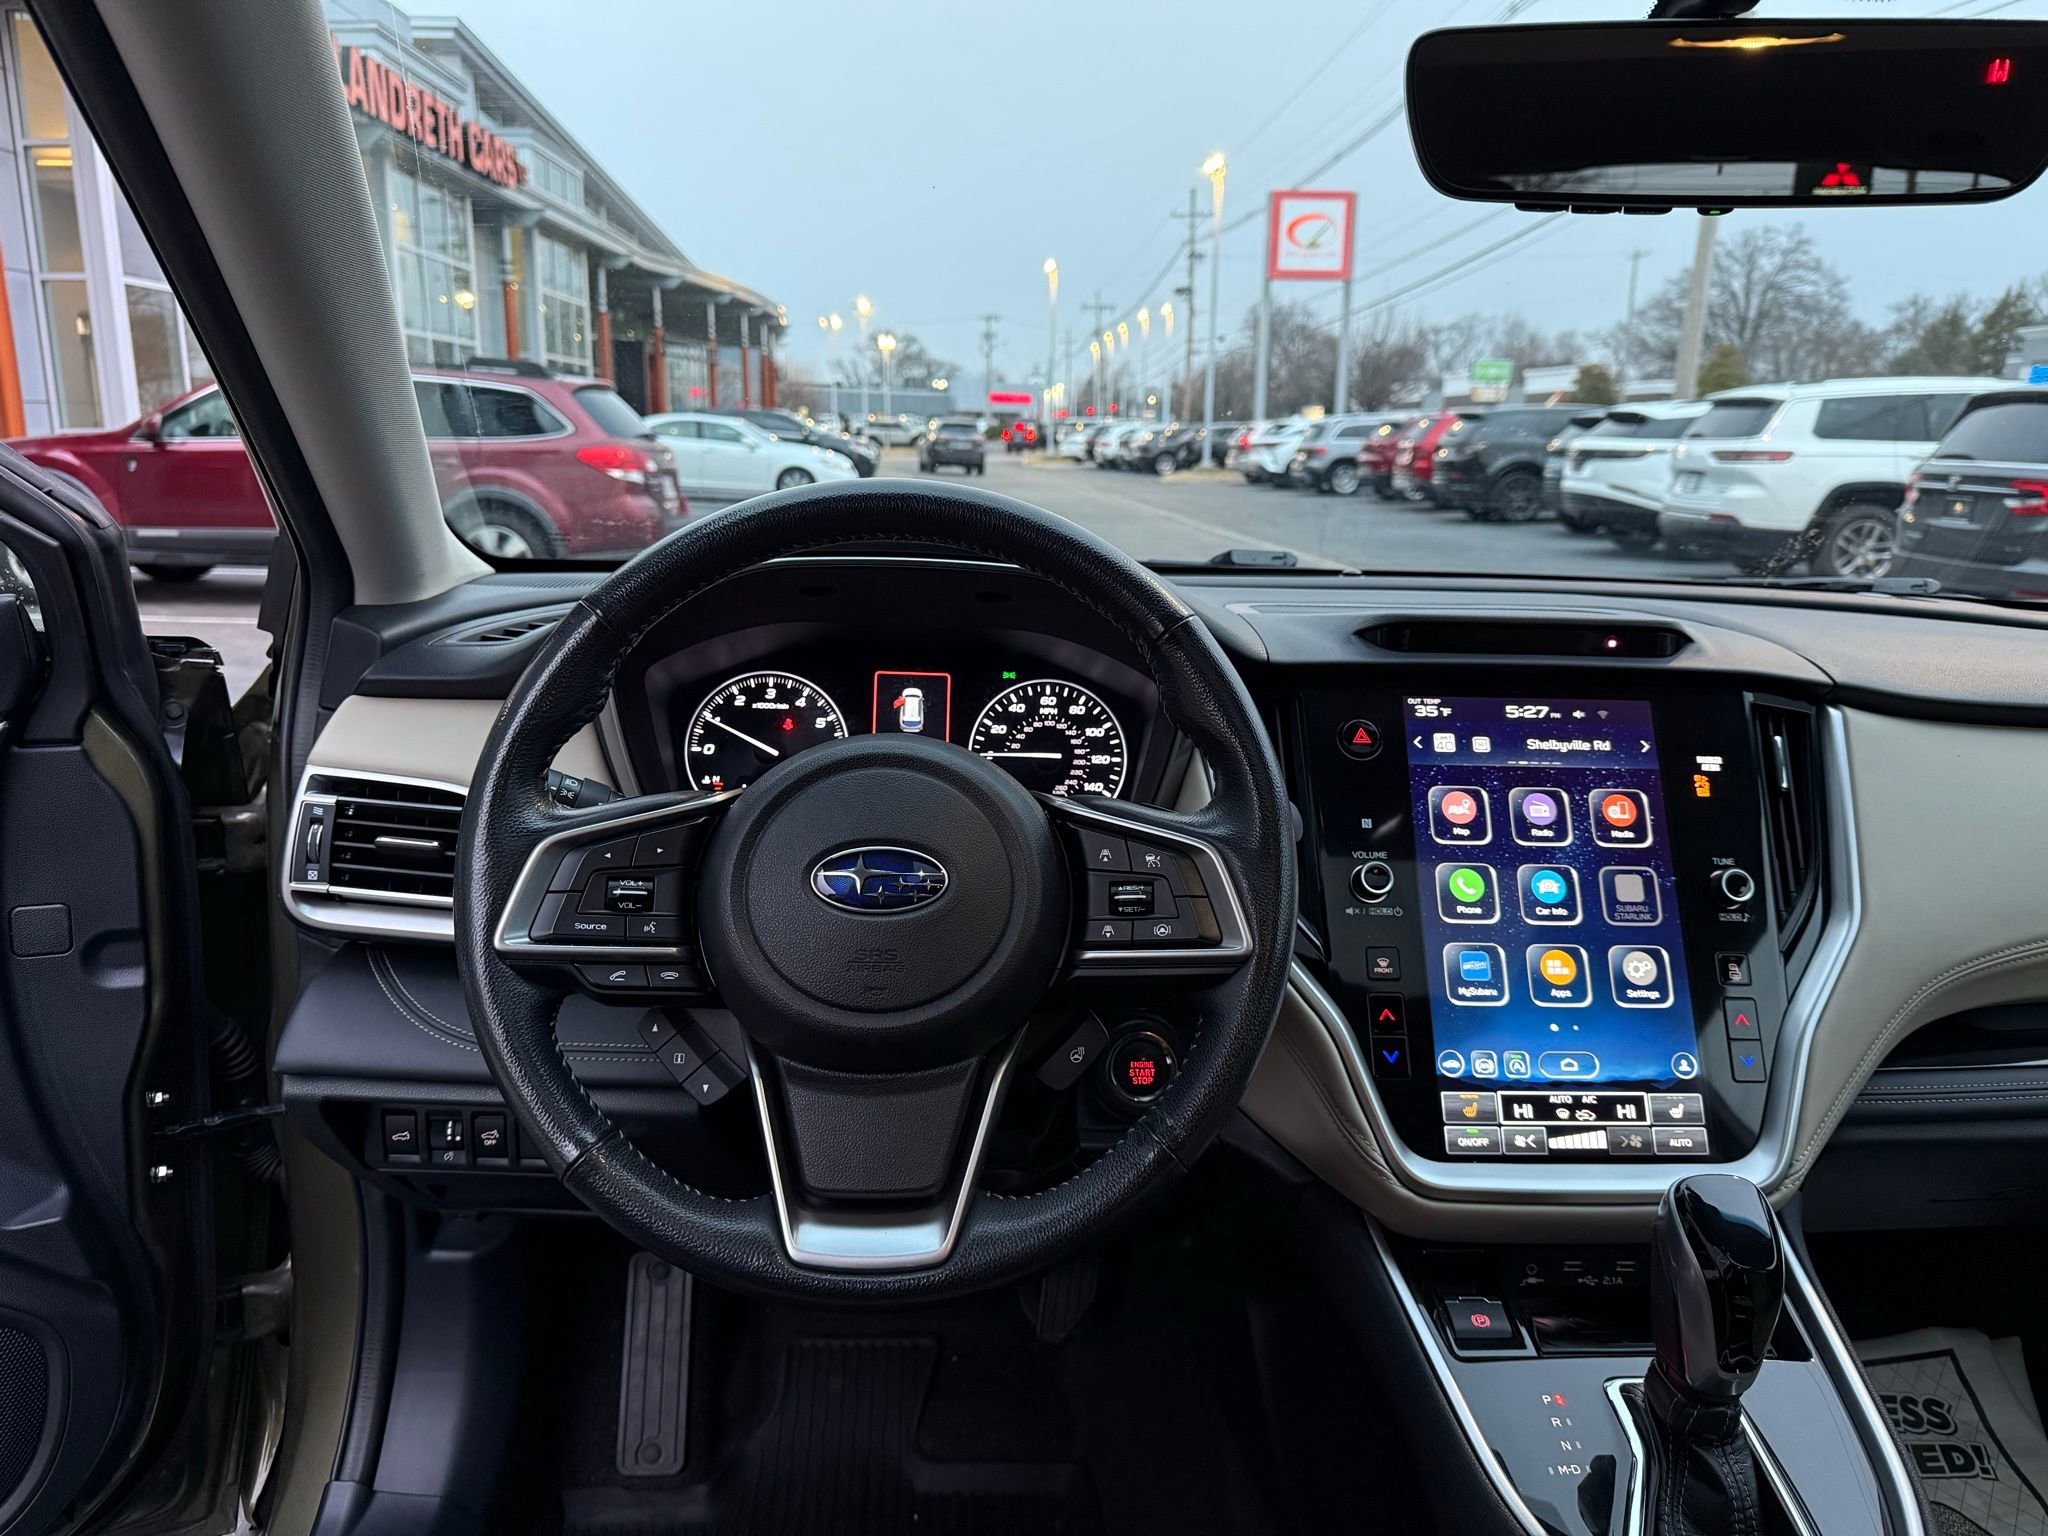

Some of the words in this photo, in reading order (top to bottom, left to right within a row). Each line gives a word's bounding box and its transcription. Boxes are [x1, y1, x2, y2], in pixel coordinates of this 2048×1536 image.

[765, 688, 776, 699] 3
[734, 695, 746, 706] 2
[795, 697, 806, 707] 4
[1040, 696, 1057, 706] 60
[1008, 704, 1026, 713] 40
[1039, 707, 1058, 715] MPH
[1069, 706, 1086, 715] 80
[1505, 705, 1549, 719] 5:27
[815, 718, 826, 728] 5
[990, 725, 1007, 734] 20
[1085, 728, 1105, 737] 100
[703, 744, 715, 755] 0
[1526, 739, 1591, 753] Shelbyville
[1594, 741, 1611, 751] Rd
[1090, 755, 1111, 764] 120
[1083, 782, 1104, 791] 140
[1531, 829, 1554, 837] Radio
[1611, 830, 1635, 838] Media
[1352, 851, 1388, 859] VOLUME
[1712, 857, 1736, 865] TUNE
[1457, 905, 1483, 914] Phone
[1536, 907, 1550, 915] Car
[1615, 904, 1649, 912] SUBARU
[1614, 912, 1652, 920] STARLINK
[574, 922, 607, 930] Source
[1458, 987, 1498, 996] MySubaru
[1551, 988, 1571, 998] Apps
[1626, 988, 1660, 999] Settings
[1129, 1069, 1155, 1077] START
[1132, 1077, 1153, 1085] STOP
[1582, 1096, 1598, 1104] A/C
[1513, 1104, 1533, 1119] HI
[1616, 1104, 1637, 1119] HI
[1457, 1138, 1490, 1147] ON/OFF
[1669, 1138, 1693, 1147] AUTO
[1602, 1276, 1624, 1285] 2.1A
[1542, 1394, 1552, 1405] P
[1551, 1417, 1563, 1427] R
[1561, 1441, 1572, 1450] N
